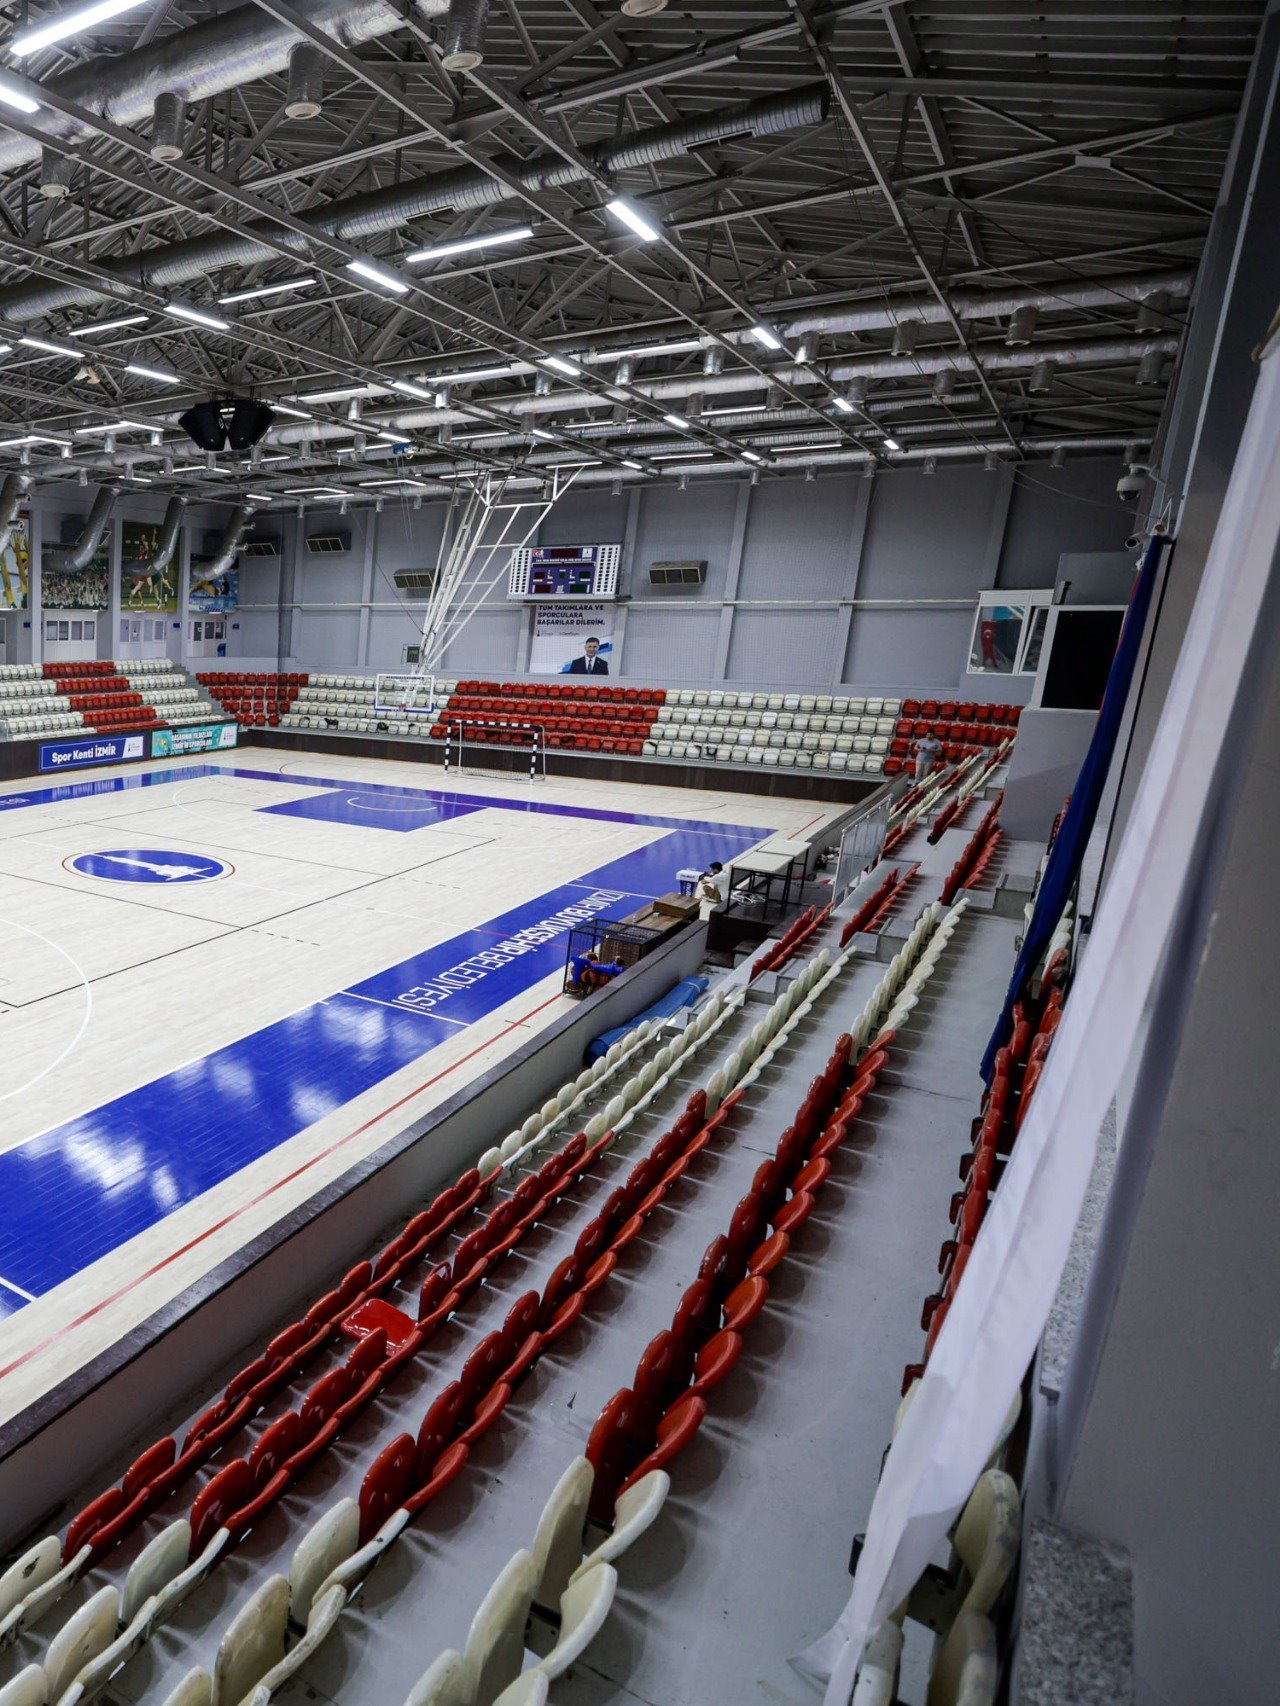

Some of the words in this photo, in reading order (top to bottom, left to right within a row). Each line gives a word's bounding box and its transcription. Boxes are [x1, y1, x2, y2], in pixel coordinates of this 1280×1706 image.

[52, 752, 71, 765] Spor
[73, 747, 94, 761] Kenti
[95, 743, 116, 757] İZMİR
[391, 951, 515, 1012] BELEDİYESİ
